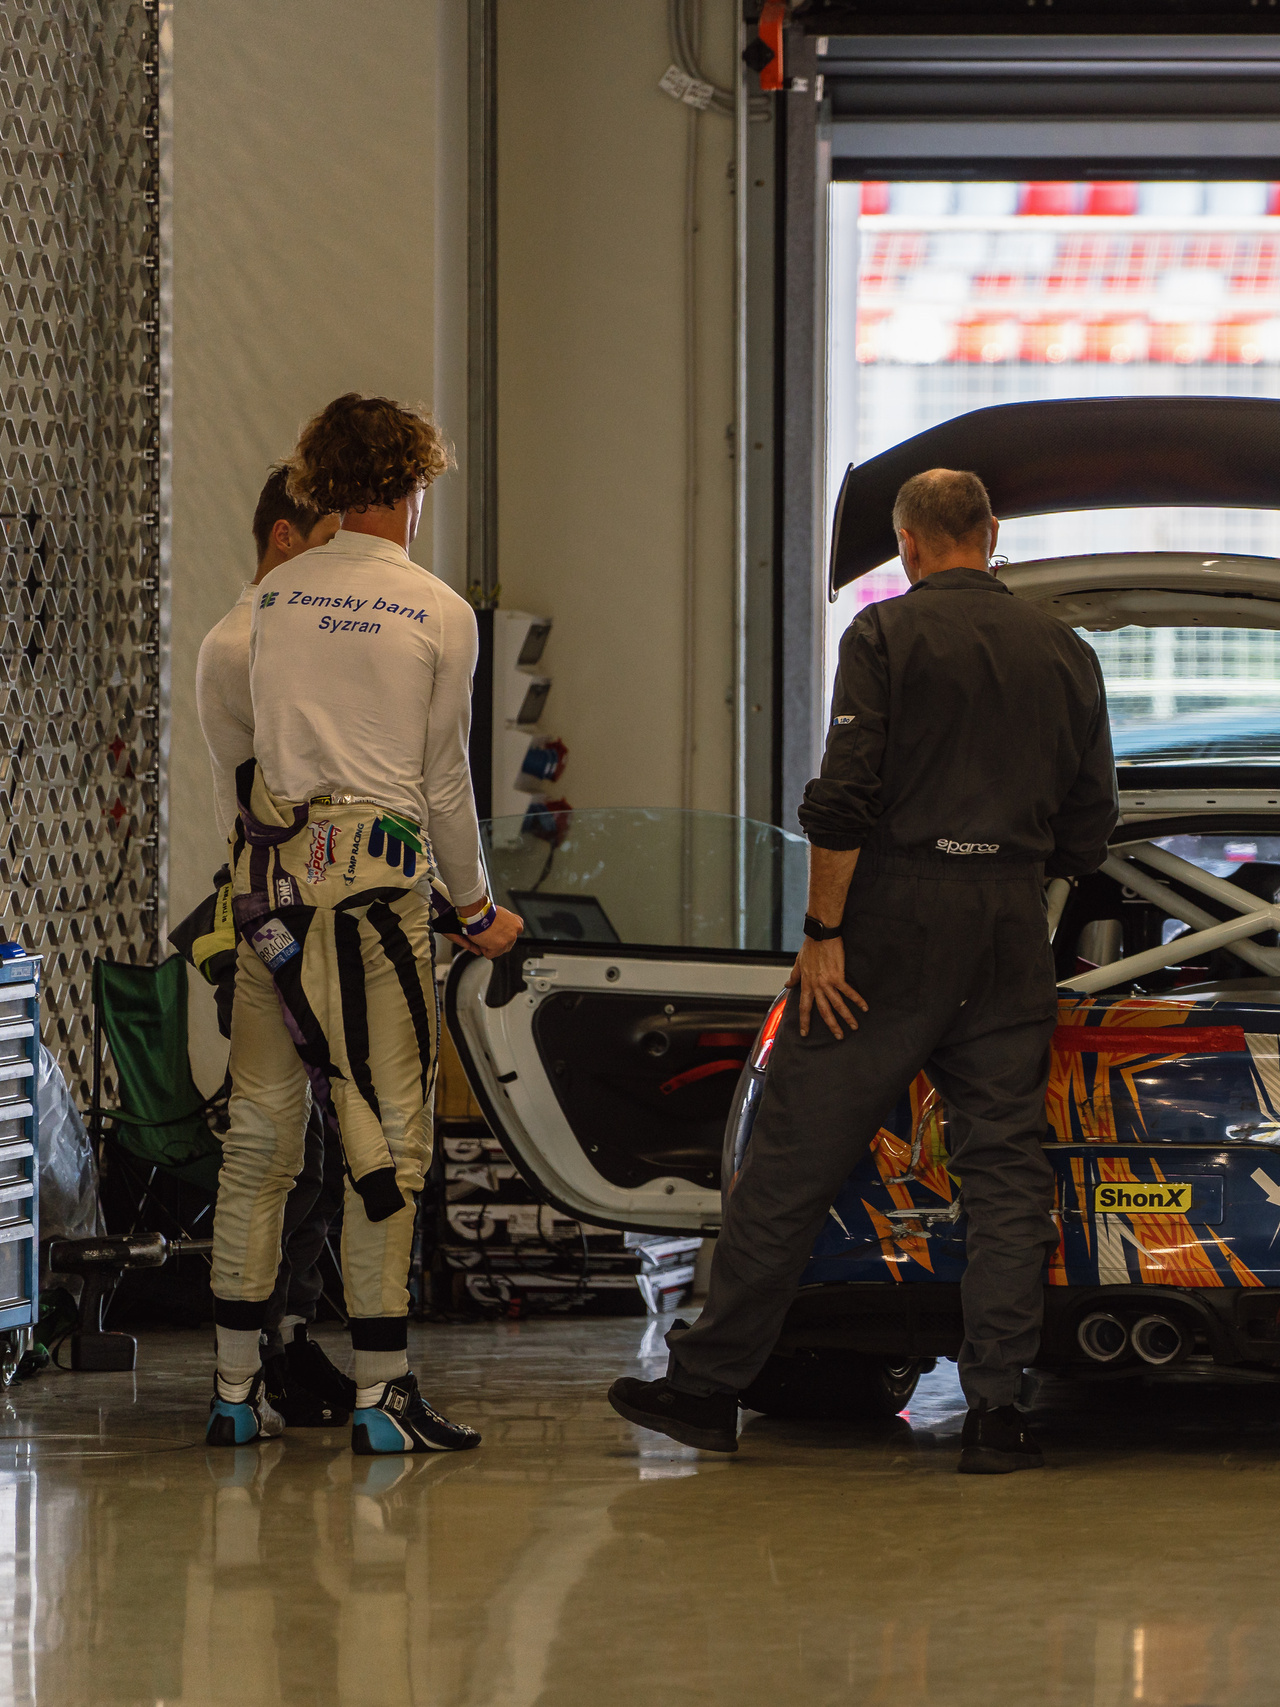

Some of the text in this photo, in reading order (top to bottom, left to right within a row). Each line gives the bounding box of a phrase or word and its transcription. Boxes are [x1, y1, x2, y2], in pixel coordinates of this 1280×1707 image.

[287, 591, 430, 624] Zemsky bank
[318, 615, 382, 634] Syzran
[312, 831, 326, 871] РСКГ
[348, 823, 365, 875] SMP RACING
[278, 878, 292, 906] OMP
[1099, 1188, 1187, 1207] ShonX
